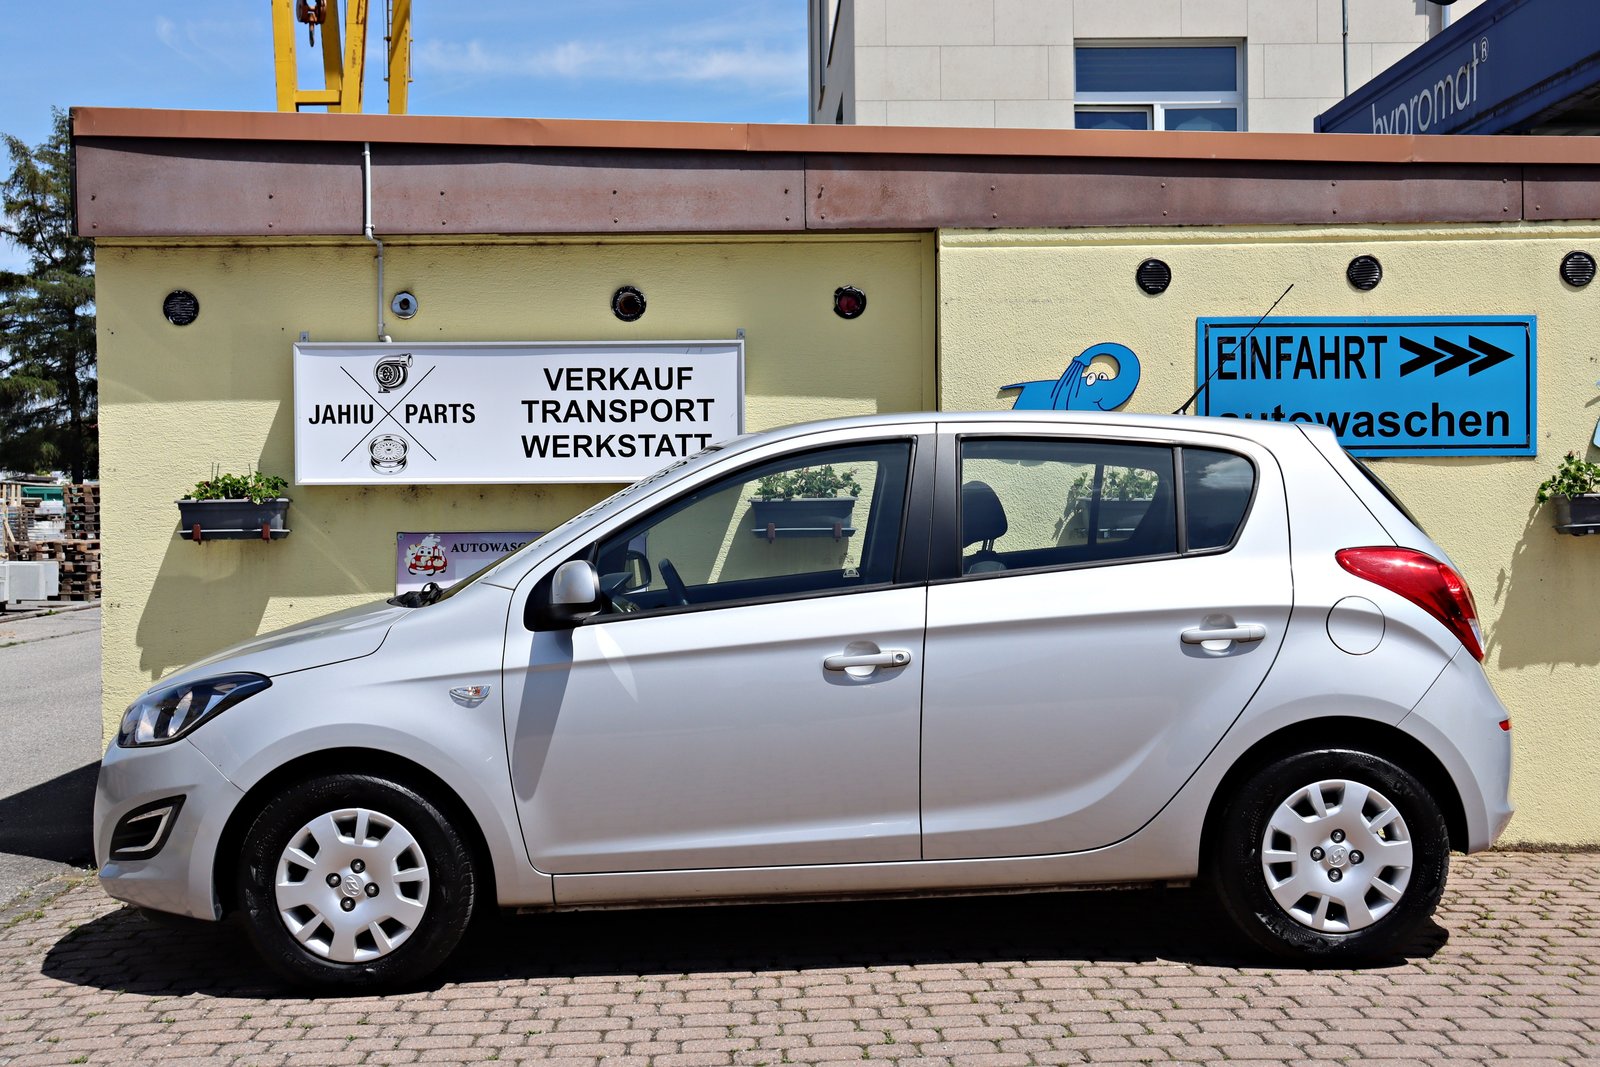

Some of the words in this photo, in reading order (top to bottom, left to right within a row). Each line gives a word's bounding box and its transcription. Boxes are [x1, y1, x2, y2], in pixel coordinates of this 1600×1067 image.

[1217, 335, 1388, 380] EINFAHRT
[543, 366, 694, 392] VERKAUF
[308, 403, 375, 425] JAHIU
[404, 403, 476, 424] PARTS
[520, 398, 715, 424] TRANSPORT
[520, 433, 713, 459] WERKSTATT
